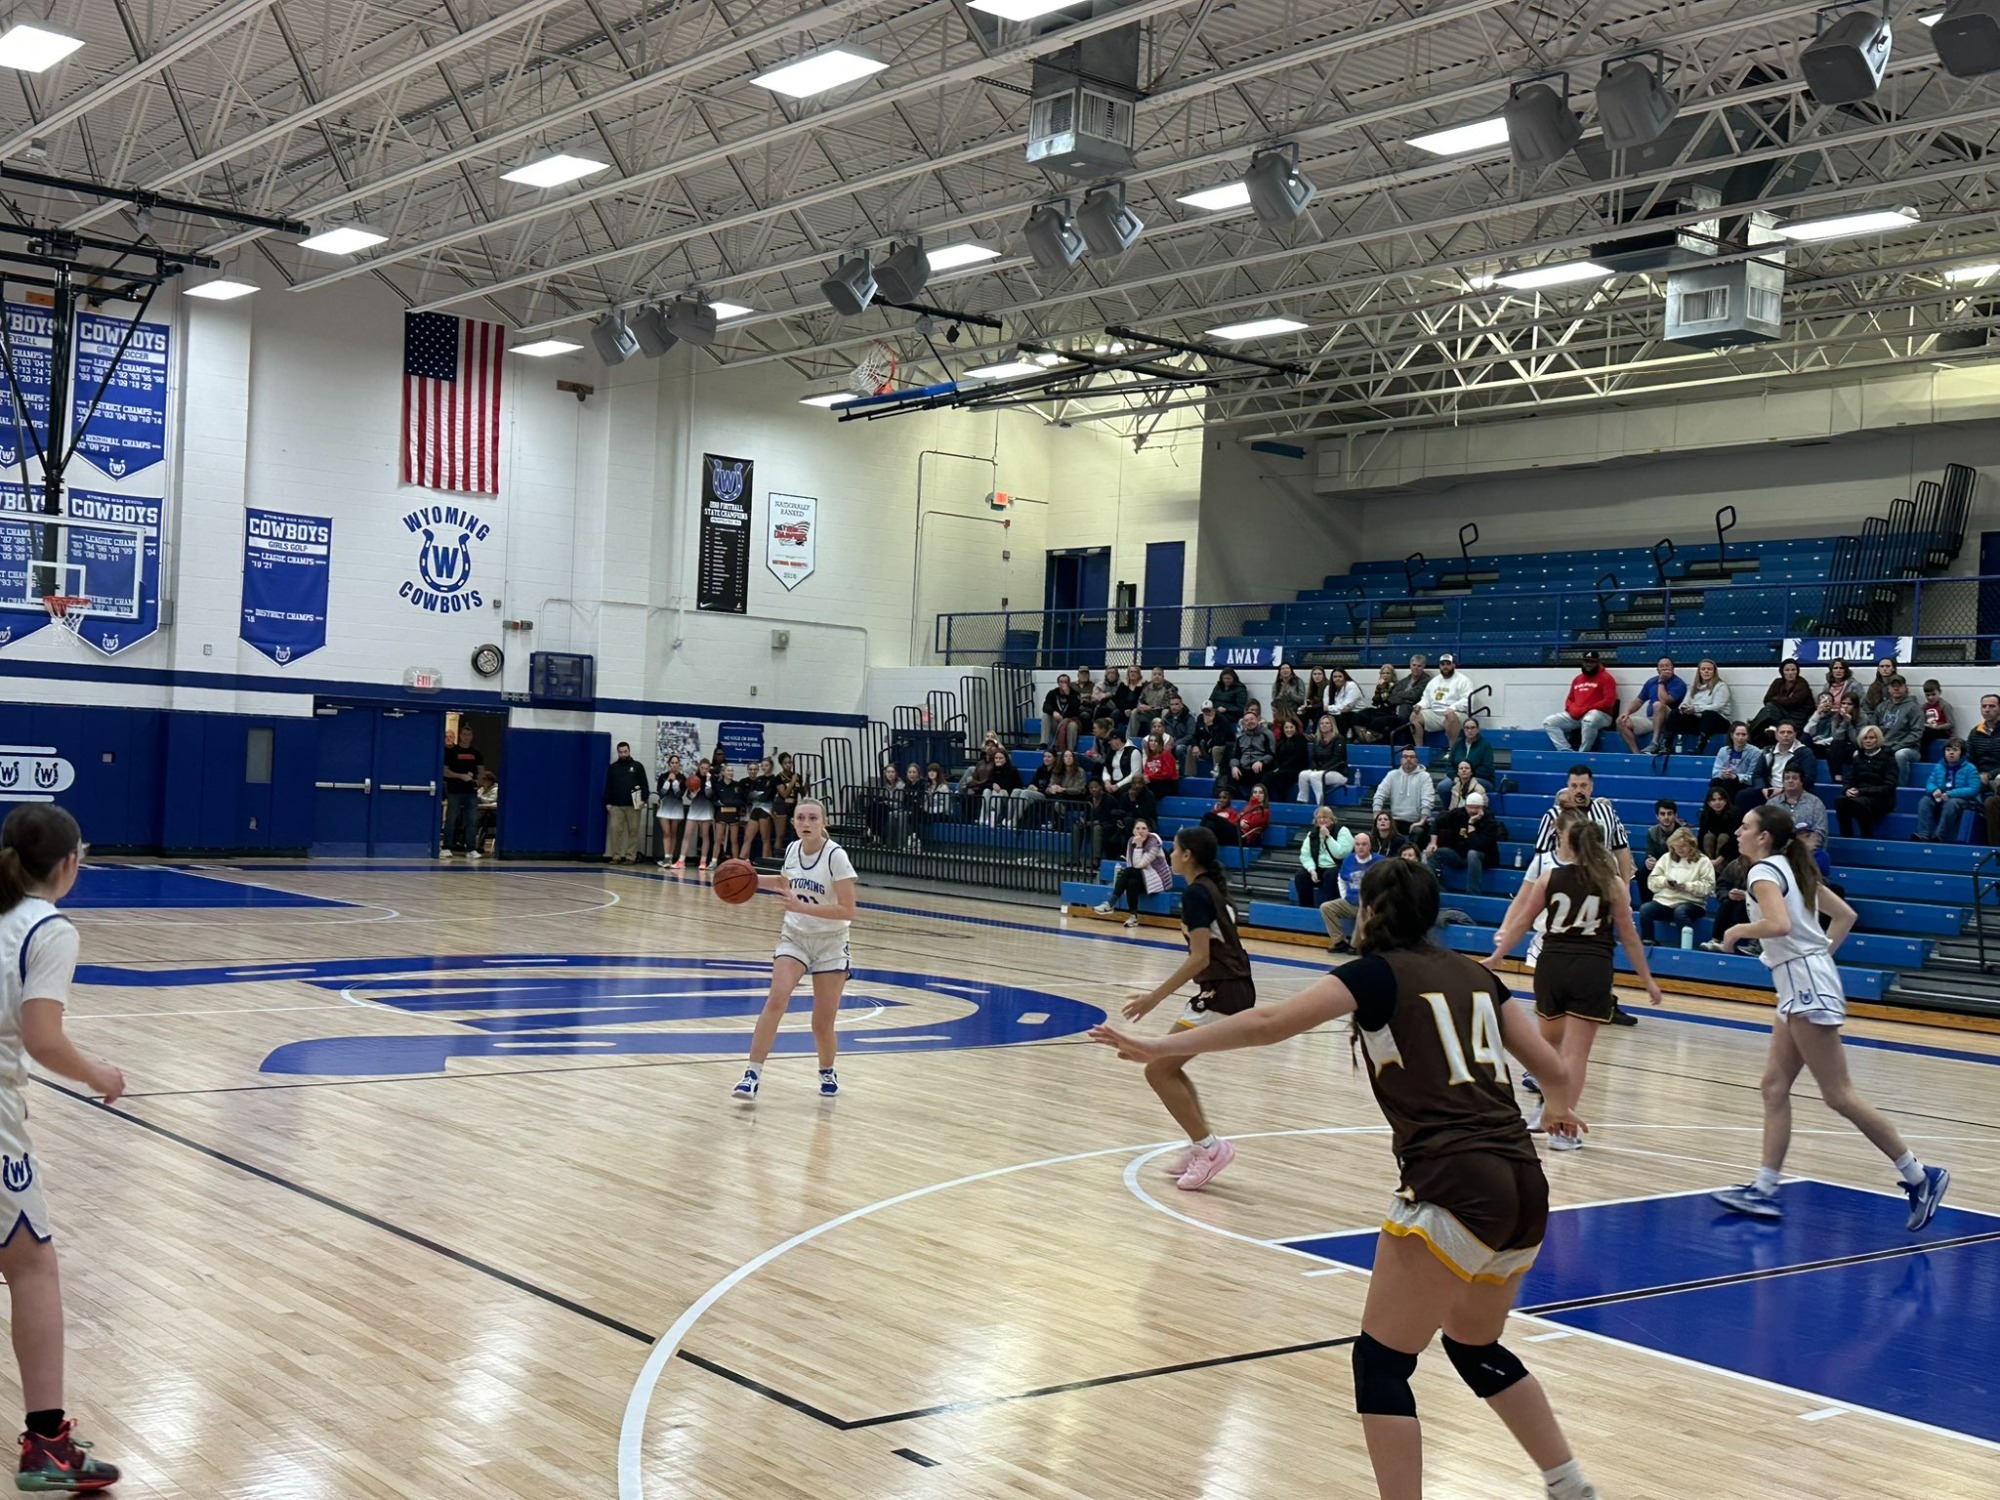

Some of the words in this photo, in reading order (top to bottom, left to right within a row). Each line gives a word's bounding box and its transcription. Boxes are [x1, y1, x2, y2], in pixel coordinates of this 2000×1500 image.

[720, 469, 737, 492] W
[71, 498, 158, 524] COWBOYS
[402, 505, 491, 541] WYOMING
[249, 517, 329, 543] COWBOYS
[287, 556, 315, 566] CHAMPS
[432, 545, 459, 579] W
[398, 581, 483, 614] COWBOYS
[286, 612, 314, 622] CHAMPS
[1226, 648, 1260, 665] AWAY
[1817, 640, 1876, 661] HOME
[1, 767, 14, 781] W
[40, 768, 53, 782] W
[1550, 892, 1602, 936] 24
[1419, 991, 1509, 1086] 14
[10, 1160, 25, 1184] W
